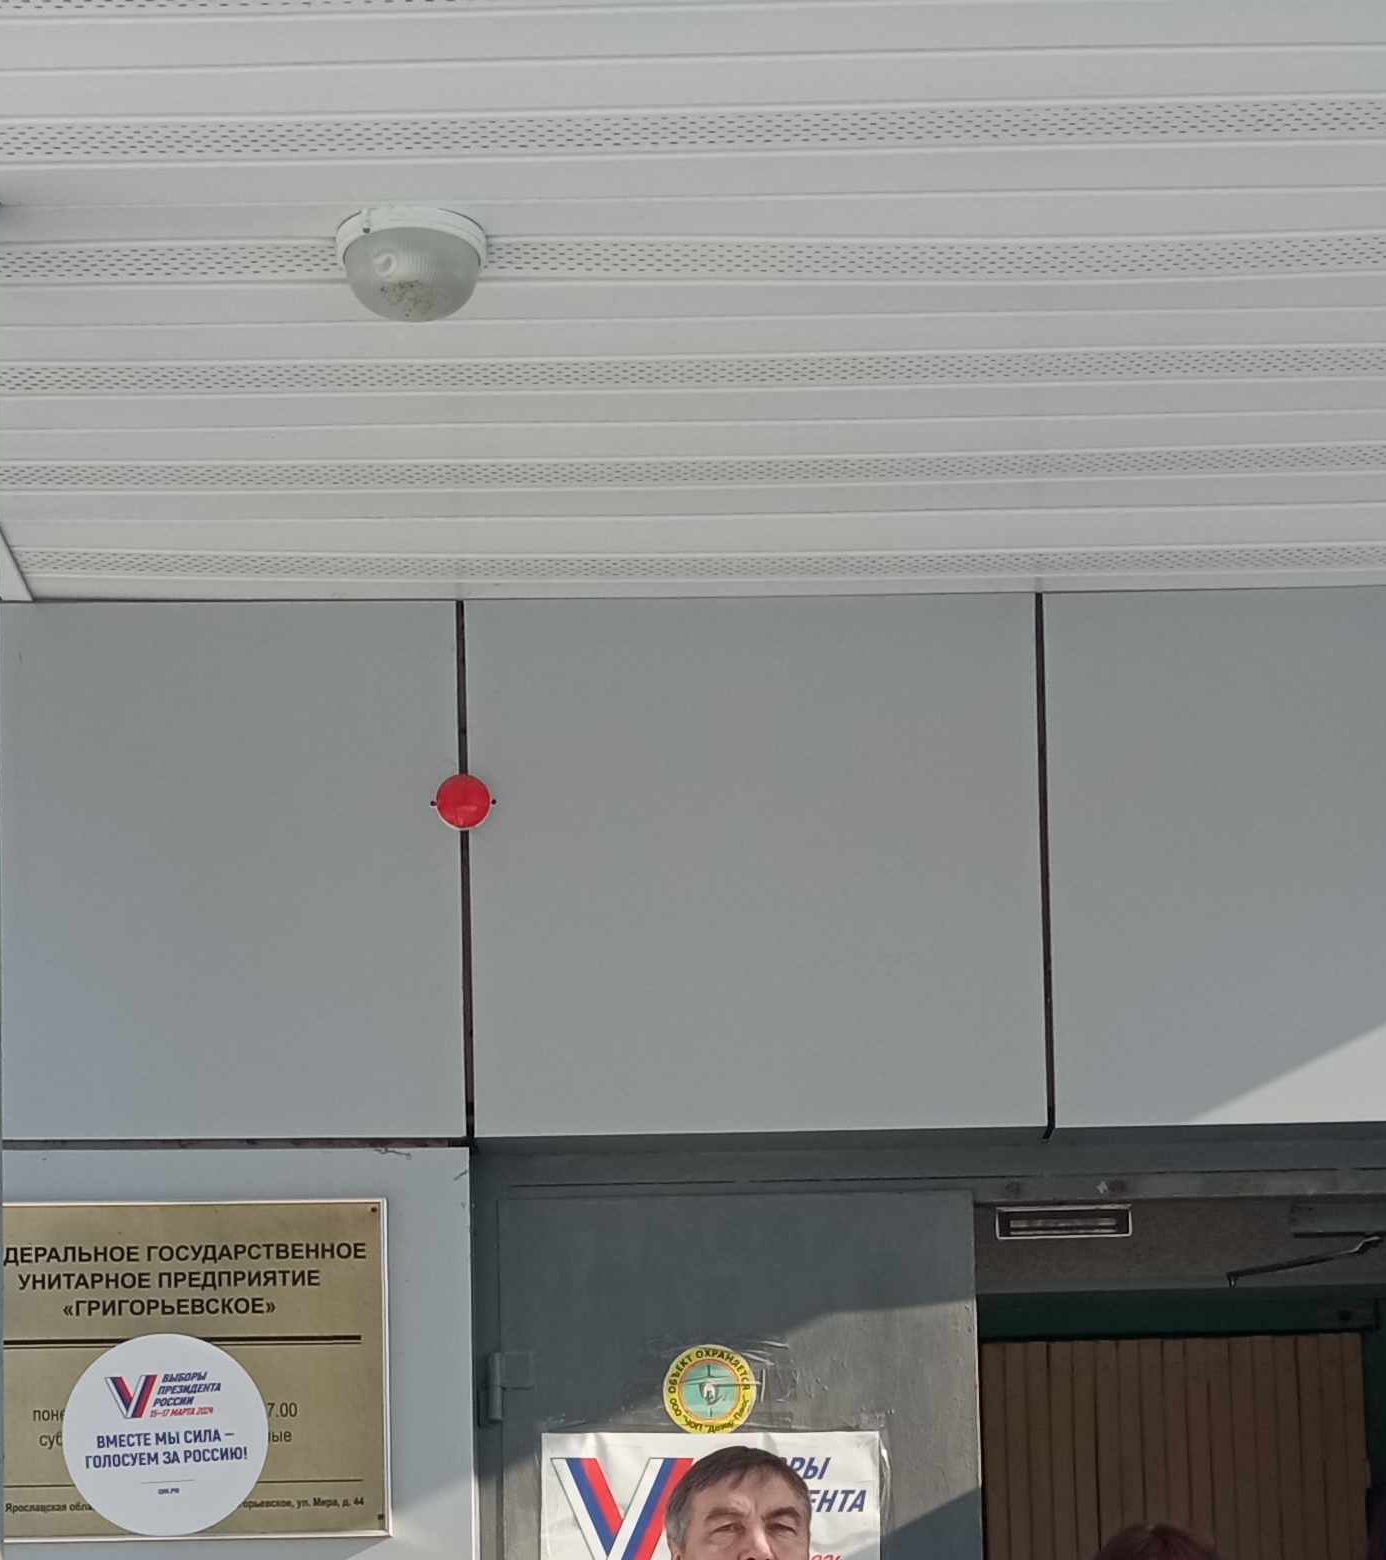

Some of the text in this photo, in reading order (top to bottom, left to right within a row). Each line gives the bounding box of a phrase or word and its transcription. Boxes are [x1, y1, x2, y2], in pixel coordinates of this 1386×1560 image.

[3, 1243, 367, 1267] ДЕРАЛЬНОЕ ГОСУДАРСТВЕННОЕ
[18, 1270, 321, 1291] УНИТАРНОЕ ПРЕДПРИЯТИЕ
[63, 1298, 276, 1316] «ГРИГОРЬЕВСКОЕ»
[162, 1371, 208, 1383] ВЫБОРЫ
[668, 1354, 692, 1394] ОБЪЕКТ
[695, 1349, 750, 1390] ОХРАНЯЕТСЯ
[157, 1383, 221, 1395] ПРЕЗИДЕНТА
[153, 1396, 194, 1407] РОССИИ
[267, 1402, 298, 1418] 7.00
[170, 1407, 195, 1416] МАРТА
[97, 1433, 152, 1449] ВМЕСТЕ
[155, 1431, 180, 1446] МЫ
[184, 1429, 222, 1444] СИЛА
[85, 1447, 248, 1468] ГОЛОСУЕМ ЗА РОССИЮ!
[5, 1502, 66, 1514] Ярославская
